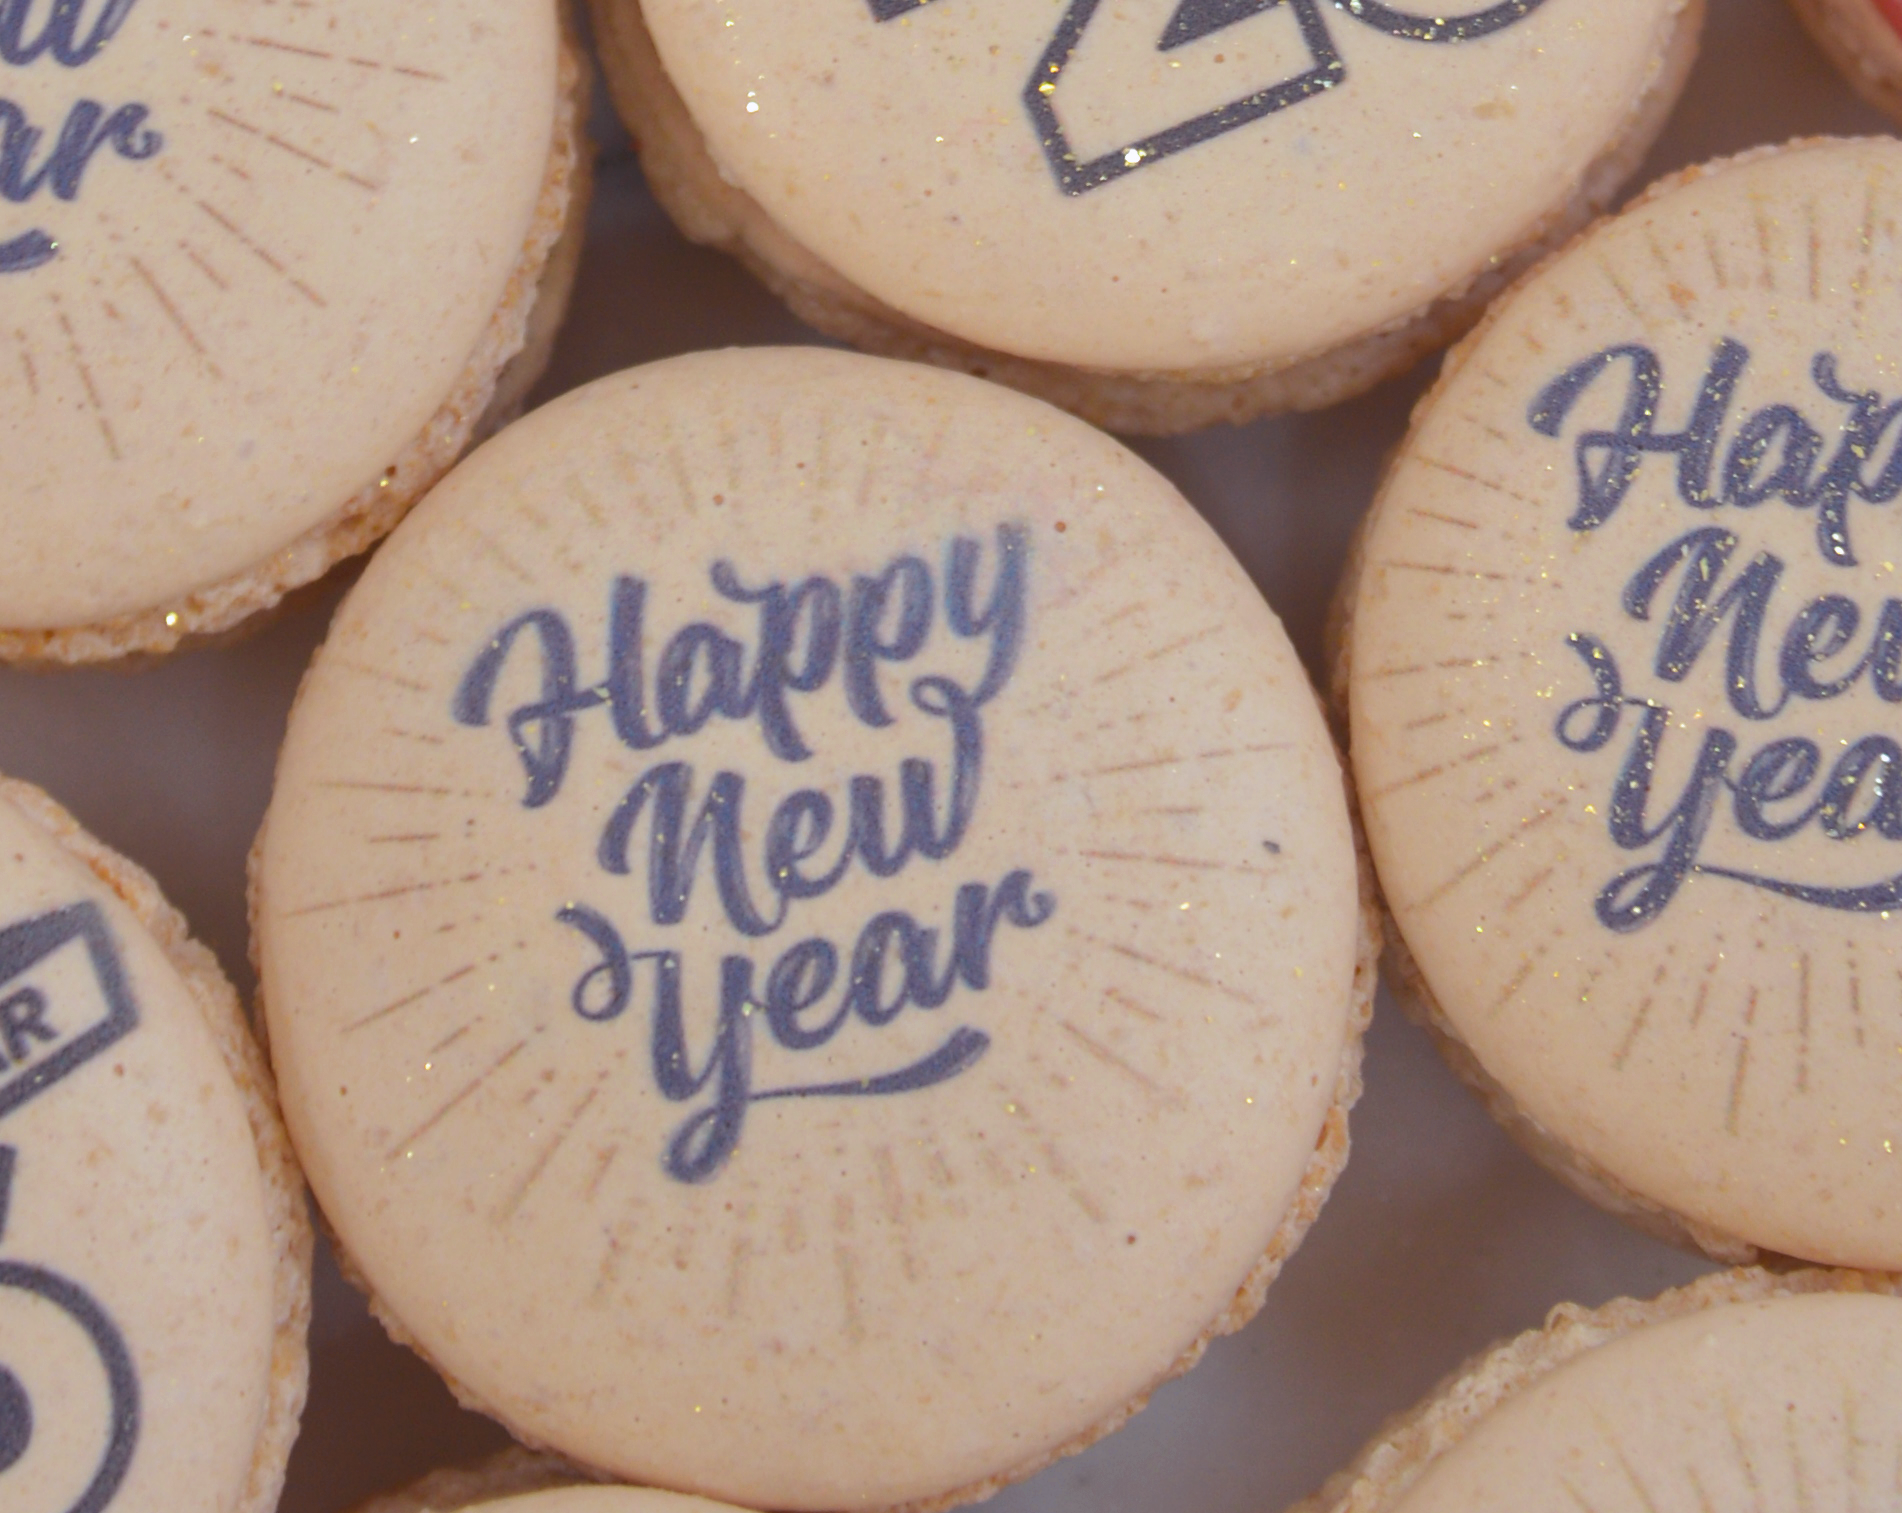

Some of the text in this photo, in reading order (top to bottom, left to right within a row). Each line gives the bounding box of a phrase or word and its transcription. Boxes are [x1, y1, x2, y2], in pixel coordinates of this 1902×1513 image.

[1526, 336, 1902, 567] Hap
[451, 521, 1030, 808] Happy
[597, 677, 983, 938] New
[1555, 631, 1902, 934] Yea
[555, 870, 1056, 1185] Year
